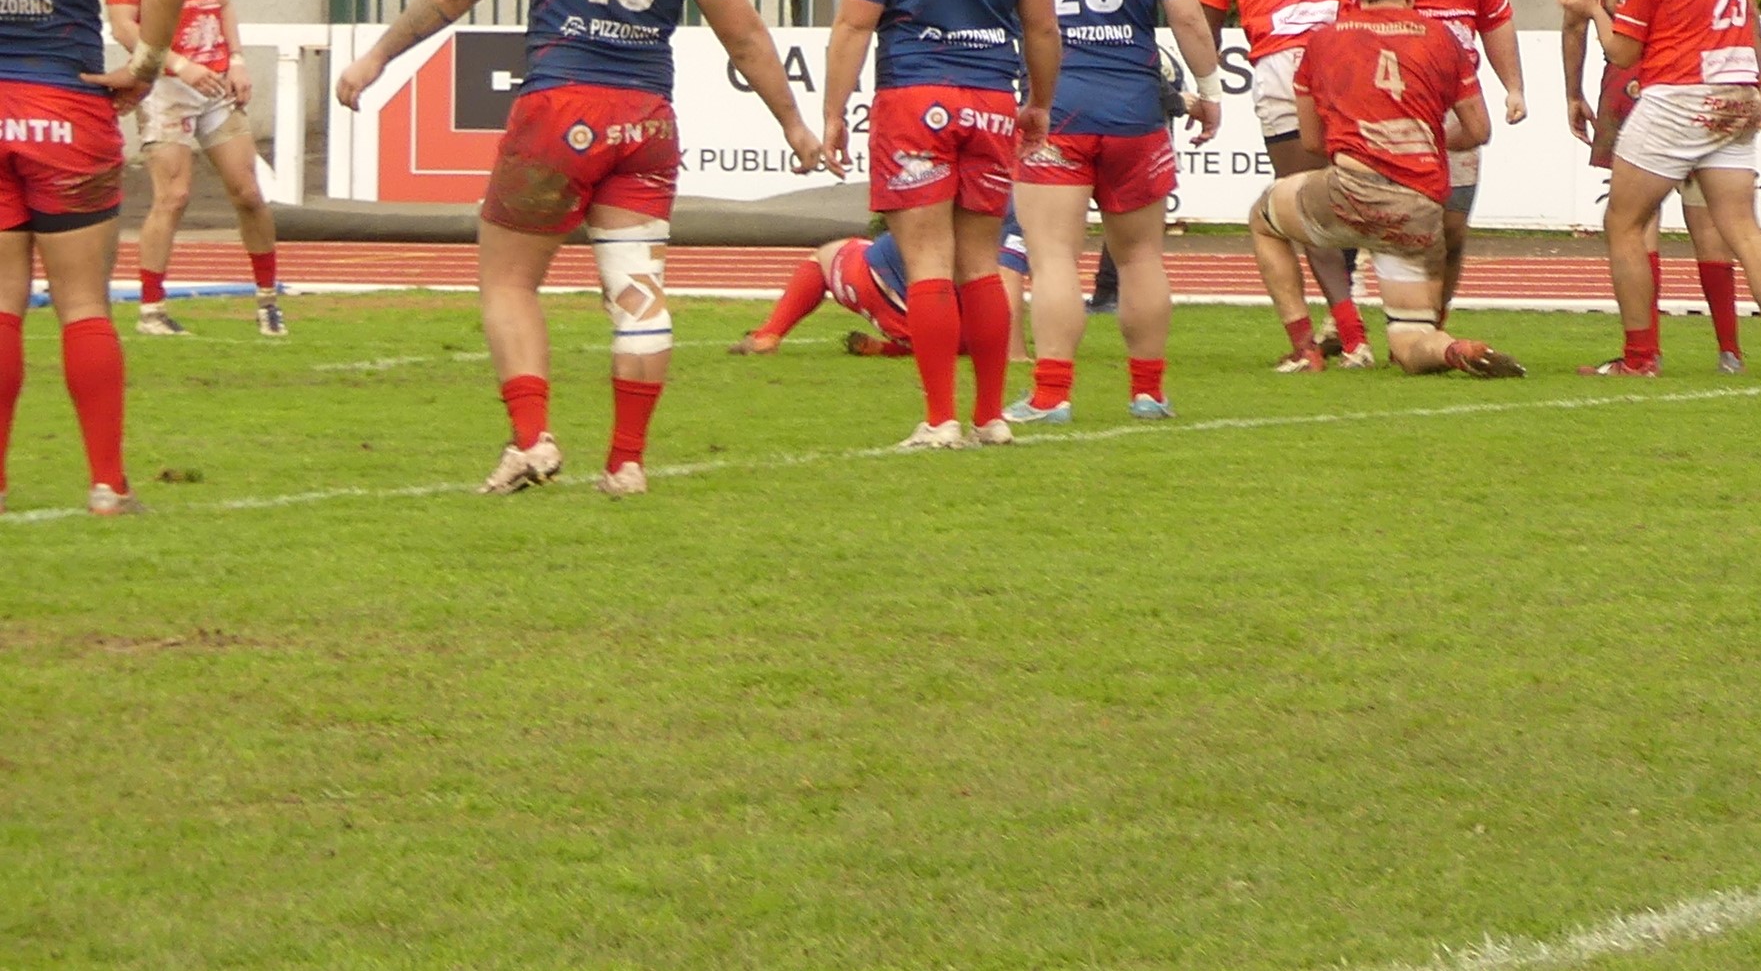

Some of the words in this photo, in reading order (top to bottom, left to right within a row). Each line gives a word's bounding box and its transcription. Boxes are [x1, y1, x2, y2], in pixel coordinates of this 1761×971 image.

[1374, 48, 1406, 102] 4
[0, 118, 73, 144] NTH
[959, 107, 1015, 136] SNTH
